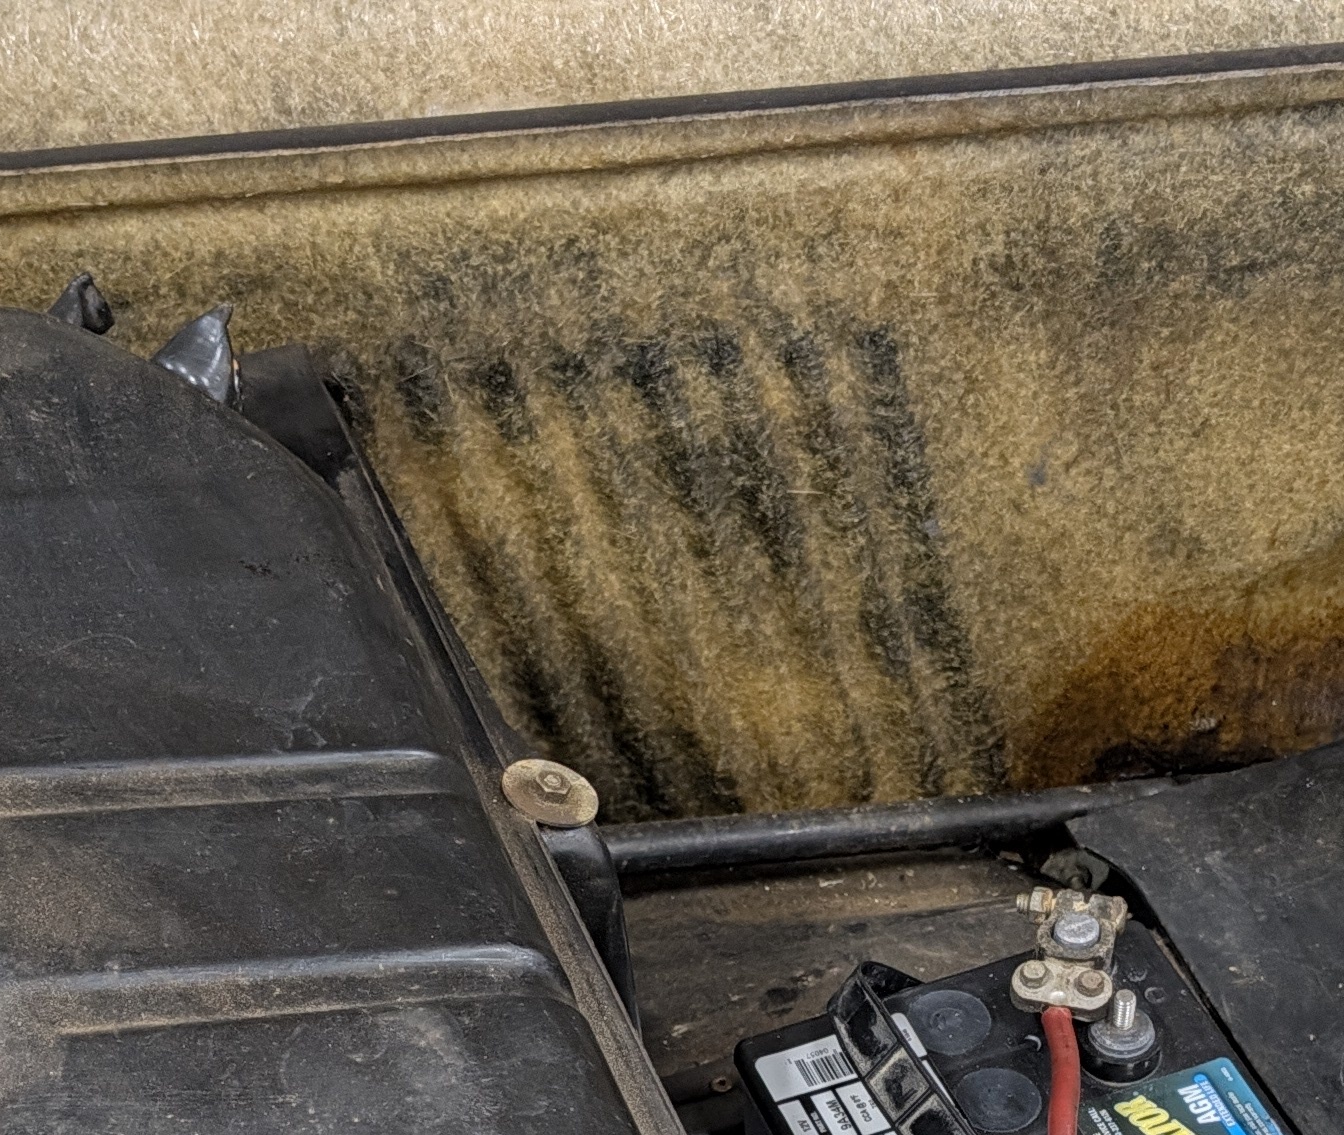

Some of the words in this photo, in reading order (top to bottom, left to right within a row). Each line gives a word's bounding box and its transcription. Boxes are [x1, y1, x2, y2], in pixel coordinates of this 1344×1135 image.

[1198, 1079, 1215, 1094] LIFE
[1176, 1082, 1222, 1127] AGM
[1207, 1093, 1237, 1127] EXTENDED
[824, 1098, 852, 1131] 9A34M
[859, 1108, 873, 1122] CCA
[1086, 1106, 1102, 1123] CALL:
[796, 1117, 811, 1132] 12V
